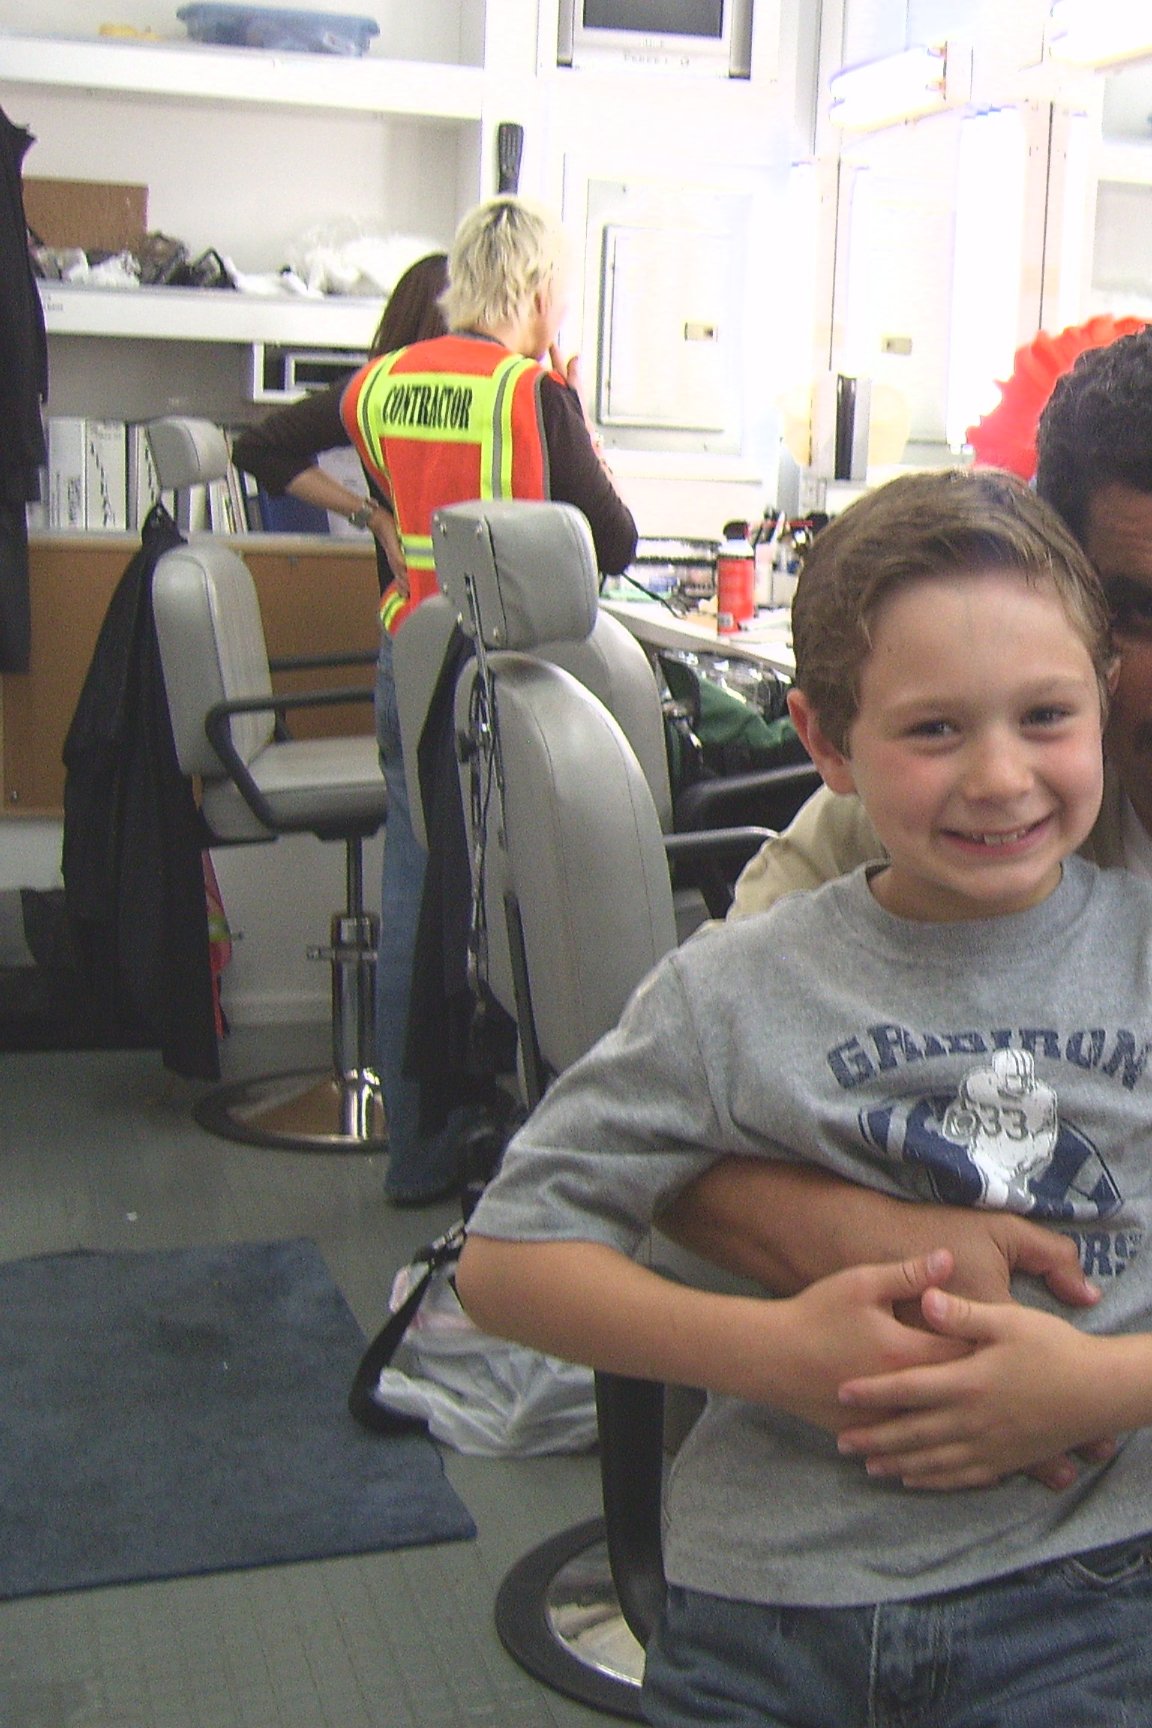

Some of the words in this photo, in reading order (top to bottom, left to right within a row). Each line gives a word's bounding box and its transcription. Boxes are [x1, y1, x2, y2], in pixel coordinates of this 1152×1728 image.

[382, 383, 474, 431] CONTRACTOR
[979, 1102, 1030, 1141] 33
[1064, 1229, 1141, 1277] RS
